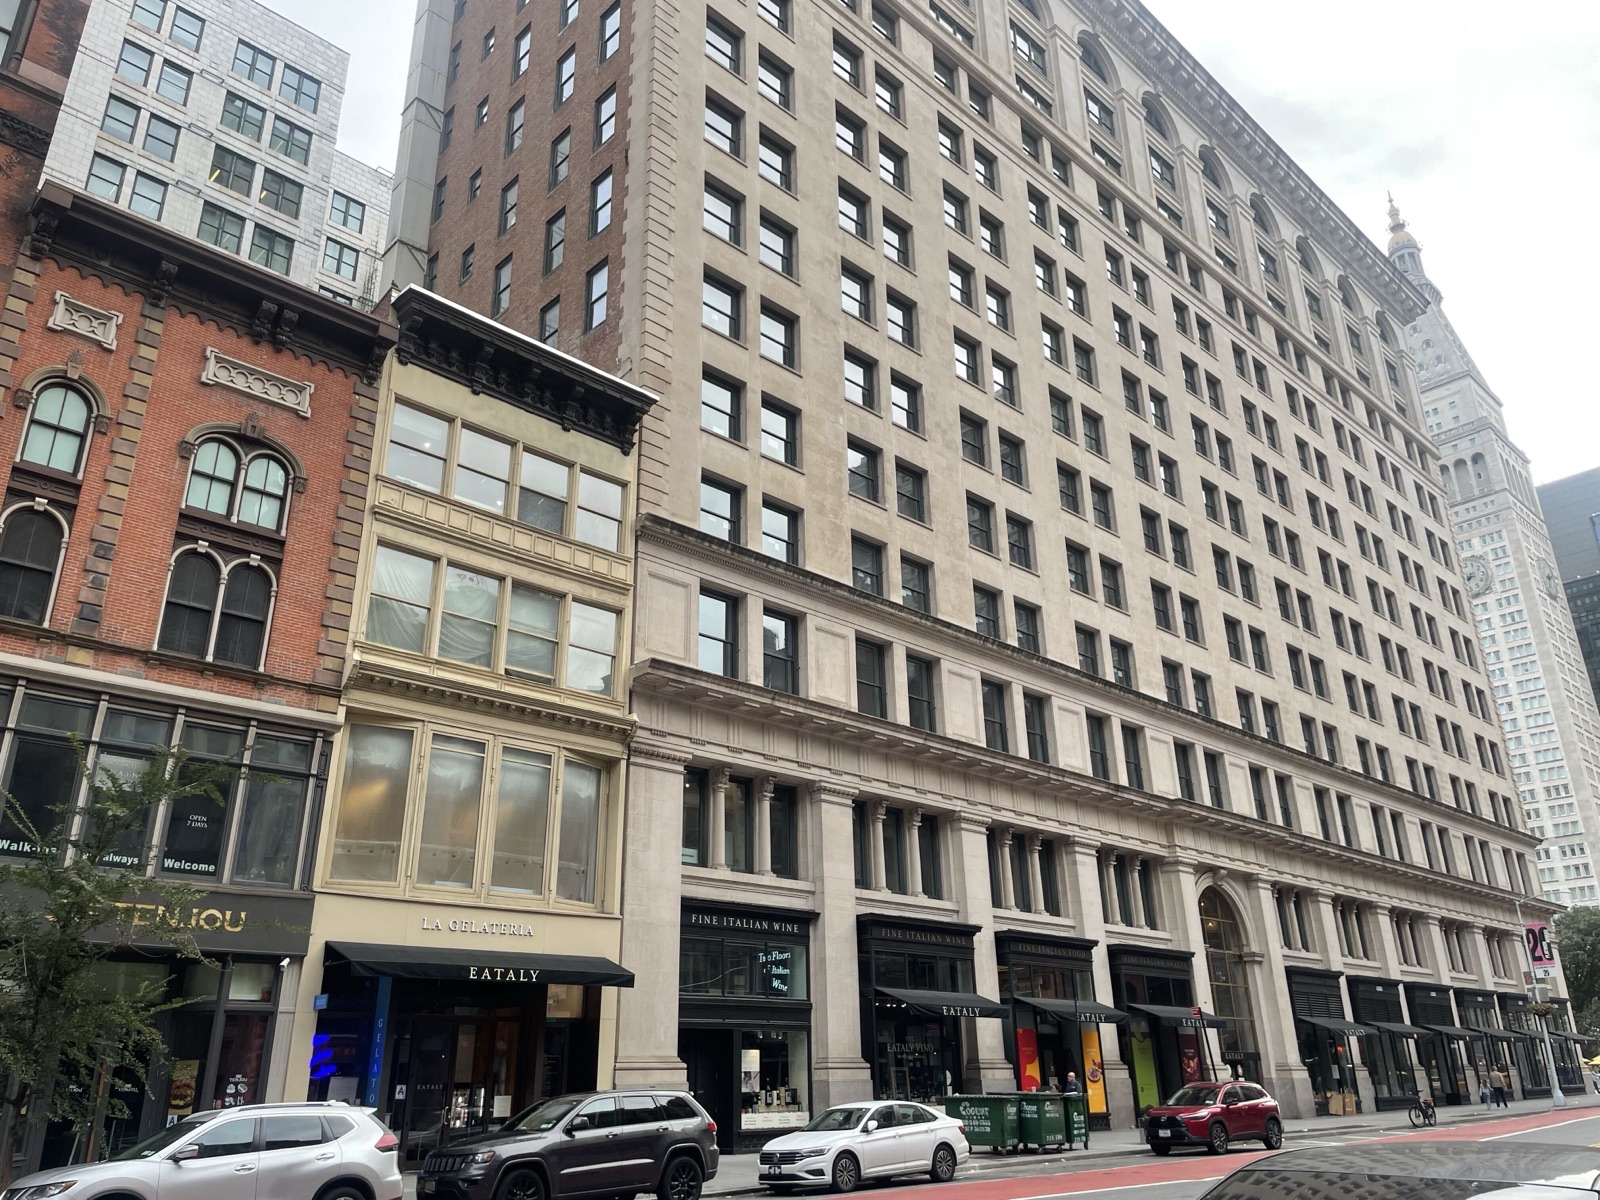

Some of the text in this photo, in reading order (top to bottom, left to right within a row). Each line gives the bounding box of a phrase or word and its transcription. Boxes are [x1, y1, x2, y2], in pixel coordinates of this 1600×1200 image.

[189, 814, 208, 822] OPEN
[192, 821, 208, 829] DAYS
[103, 853, 139, 866] always
[163, 857, 216, 873] Welcome
[422, 917, 534, 937] LA GELATERIA
[691, 913, 799, 933] FINE ITALIAN WINE
[881, 928, 966, 945] FINE ITALIAN WINE
[771, 950, 791, 961] Floors
[1018, 943, 1086, 958] FINE ITALIAN FOOD
[469, 966, 540, 982] EATALY
[771, 965, 791, 975] Italian
[772, 977, 788, 991] Wine
[942, 1006, 980, 1017] EATALY
[1077, 1012, 1106, 1022] ATALY
[887, 1042, 934, 1053] EATALY VINO
[369, 1018, 384, 1103] GELATO
[397, 1086, 405, 1096] A
